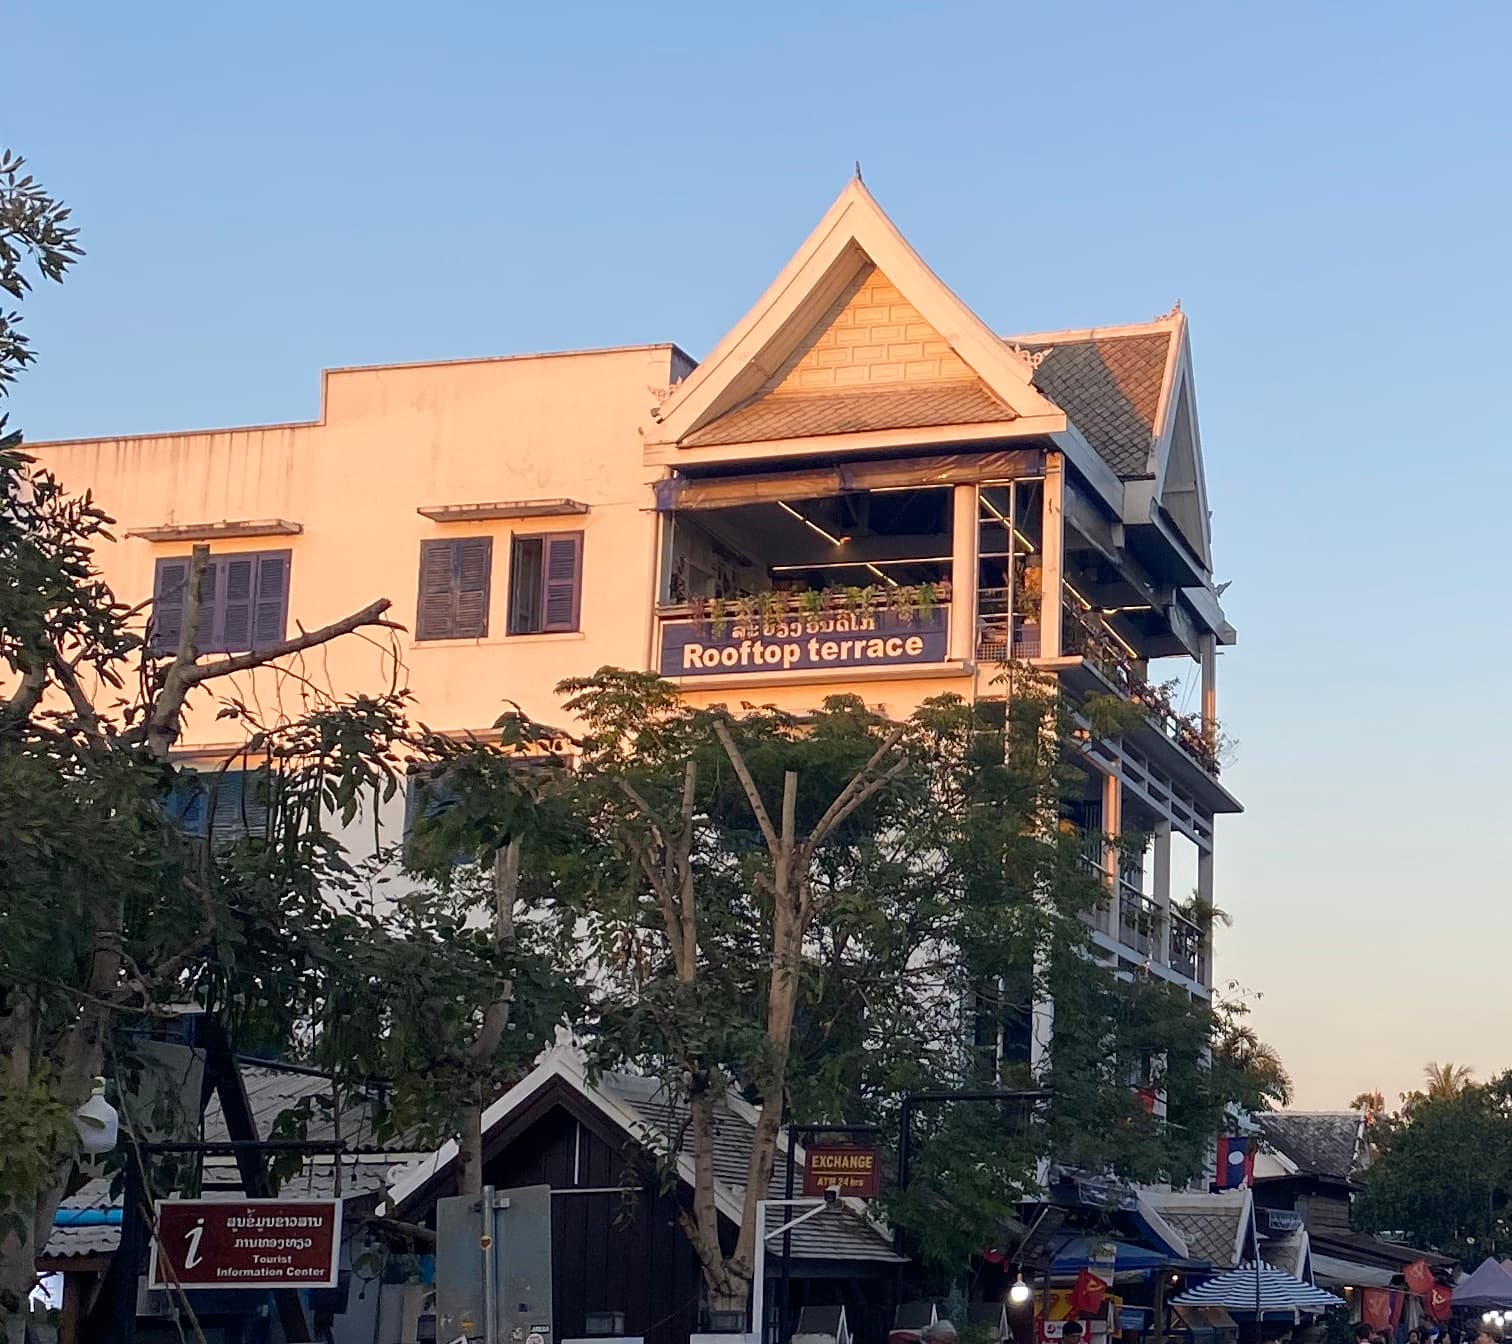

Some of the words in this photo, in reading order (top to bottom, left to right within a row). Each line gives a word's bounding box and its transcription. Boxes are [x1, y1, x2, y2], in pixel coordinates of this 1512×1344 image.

[683, 640, 800, 669] Rooftop
[807, 636, 924, 662] terrace
[812, 1155, 873, 1169] EXCHANGE
[816, 1176, 837, 1187] ATM
[838, 1176, 849, 1187] 24
[850, 1177, 864, 1187] hrs
[252, 1255, 292, 1264] Tourist
[216, 1267, 283, 1277] Information
[286, 1267, 326, 1277] Center
